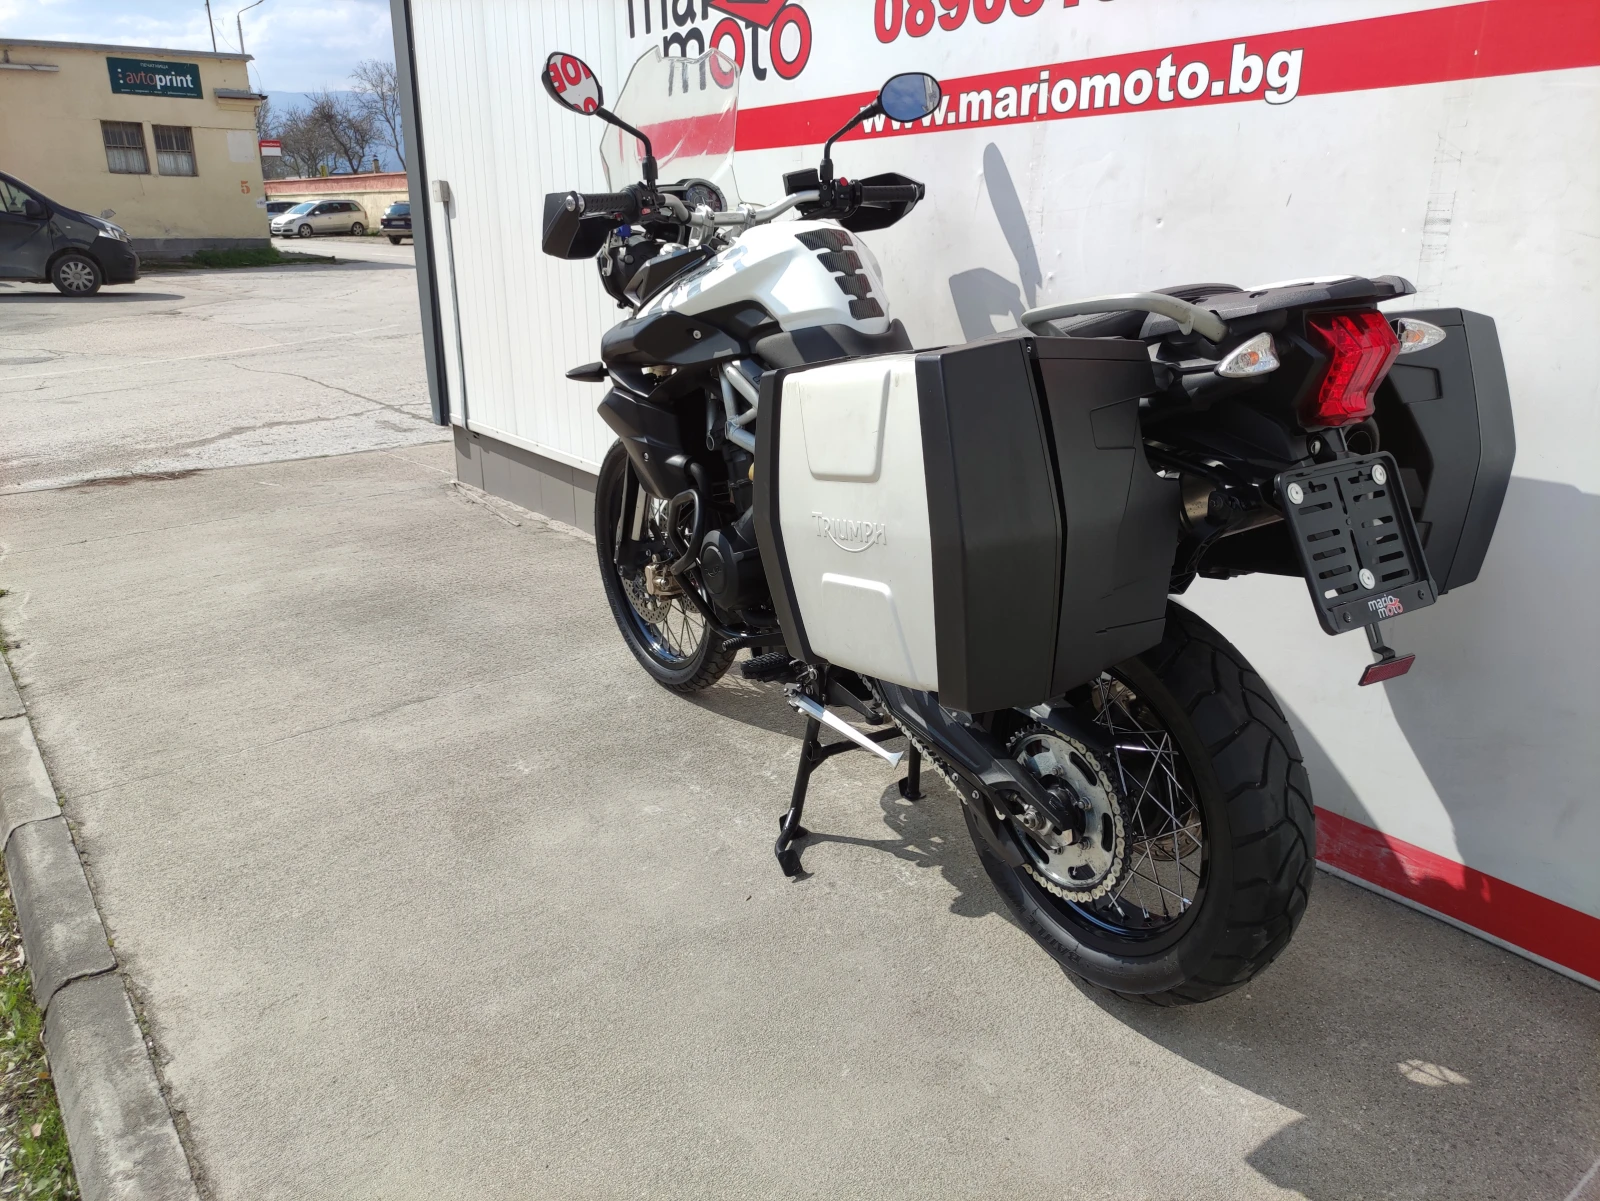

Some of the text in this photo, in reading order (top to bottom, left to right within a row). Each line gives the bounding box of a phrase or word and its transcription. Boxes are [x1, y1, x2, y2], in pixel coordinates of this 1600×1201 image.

[662, 3, 812, 97] moto
[125, 70, 194, 90] avtoprint
[860, 43, 1304, 134] ww.mariomoto.bg
[241, 180, 250, 194] 5
[811, 510, 887, 553] TRIUMPH
[1368, 594, 1395, 611] mario
[1378, 602, 1403, 618] moto
